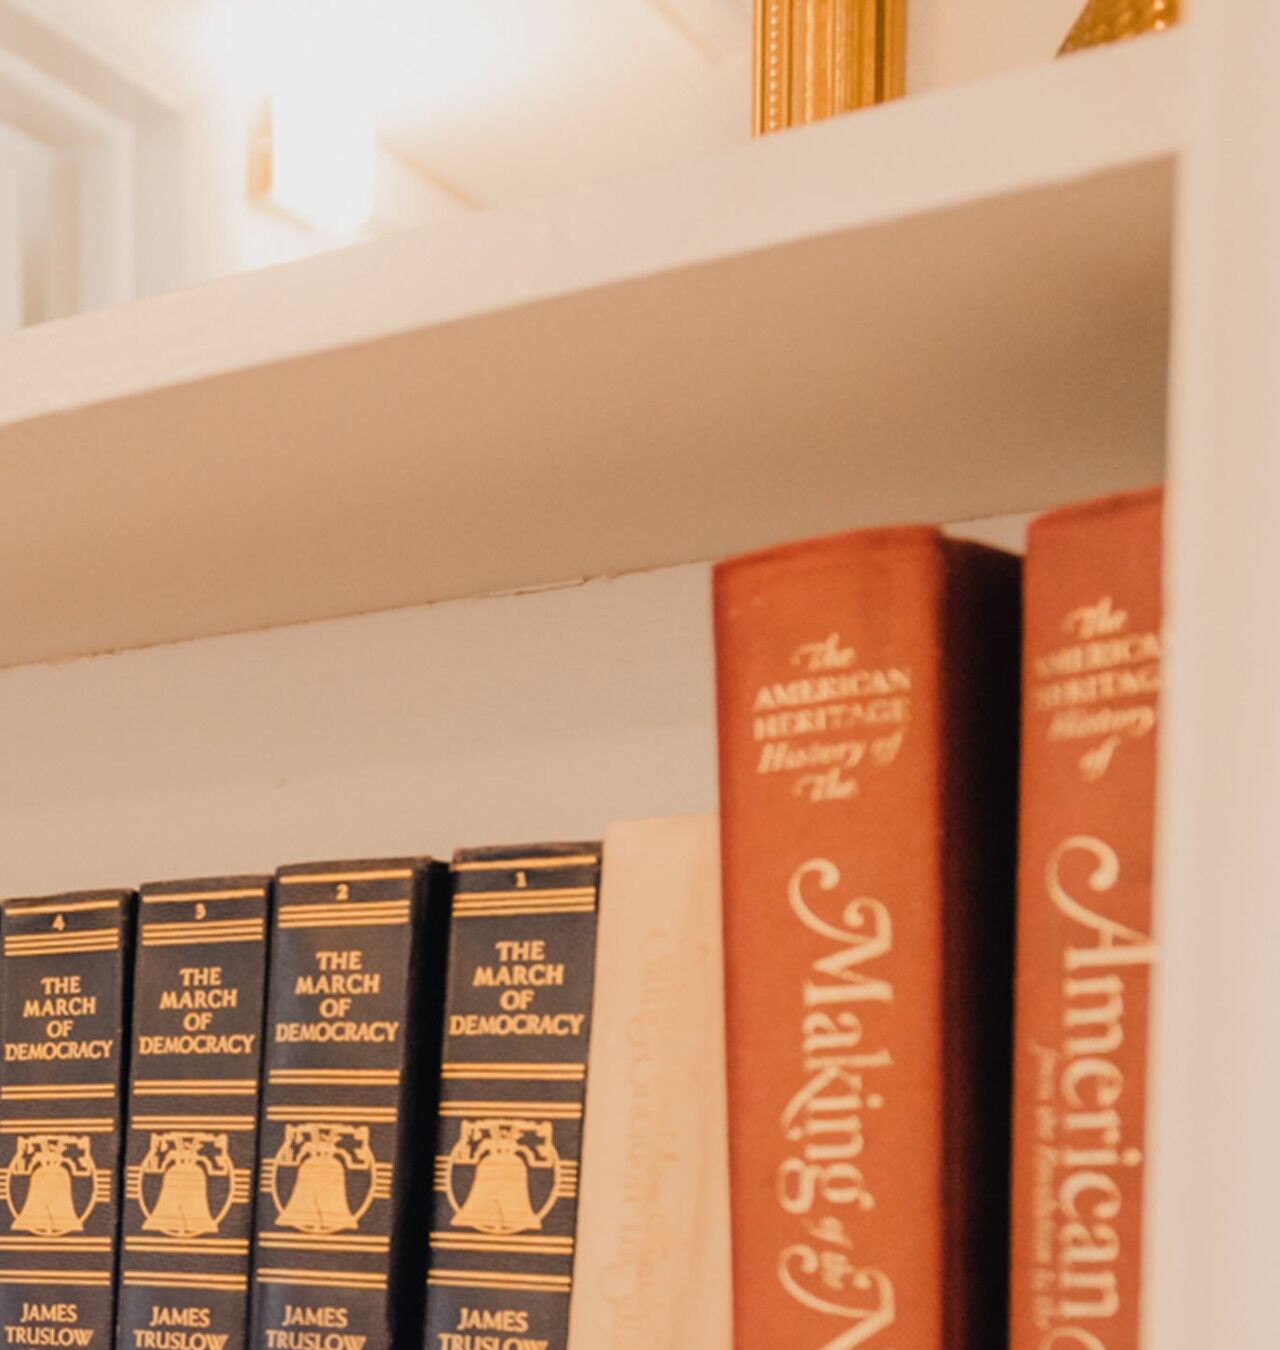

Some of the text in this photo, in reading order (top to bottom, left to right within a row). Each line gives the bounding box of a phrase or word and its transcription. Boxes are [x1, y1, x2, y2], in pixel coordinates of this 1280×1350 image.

[790, 632, 855, 672] The
[753, 667, 912, 711] AMERICAN
[753, 697, 910, 742] HERITAGE
[315, 951, 362, 971] THE
[495, 940, 546, 962] THE
[41, 976, 81, 996] THE
[179, 966, 223, 988] THE
[294, 973, 381, 995] MARCH
[473, 964, 565, 987] MARCH
[23, 996, 96, 1018] MARCH
[159, 988, 238, 1010] MARCH
[319, 998, 352, 1018] OF
[499, 989, 535, 1011] OF
[46, 1020, 74, 1039] OF
[183, 1012, 213, 1032] OF
[275, 1021, 400, 1043] DEMOCRACY
[449, 1013, 585, 1036] DEMOCRACY
[139, 1034, 256, 1055] DEMOCRACY
[776, 857, 895, 1214] Making
[4, 1040, 113, 1062] DEMOCRACY
[1045, 834, 1160, 1318] American
[20, 1302, 78, 1324] JAMES
[149, 1305, 211, 1327] JAMES
[281, 1305, 349, 1329] JAMES
[457, 1307, 529, 1333] JAMES
[4, 1325, 94, 1347] TRUSLOW
